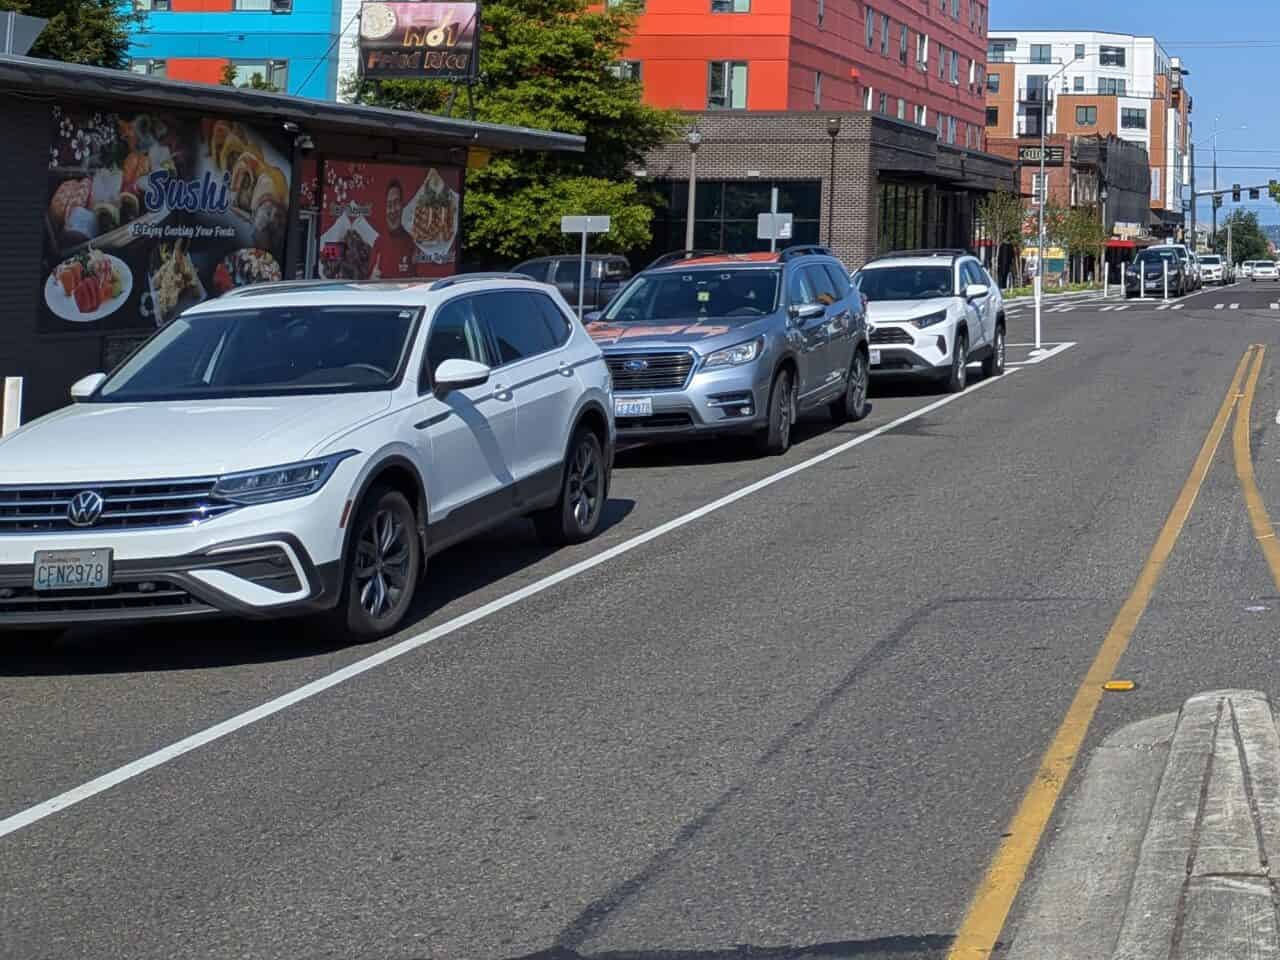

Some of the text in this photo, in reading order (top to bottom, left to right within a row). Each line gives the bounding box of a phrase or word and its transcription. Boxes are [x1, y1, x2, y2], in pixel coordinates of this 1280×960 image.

[423, 51, 468, 69] Rice
[144, 168, 230, 214] Sushi
[195, 225, 213, 237] Your
